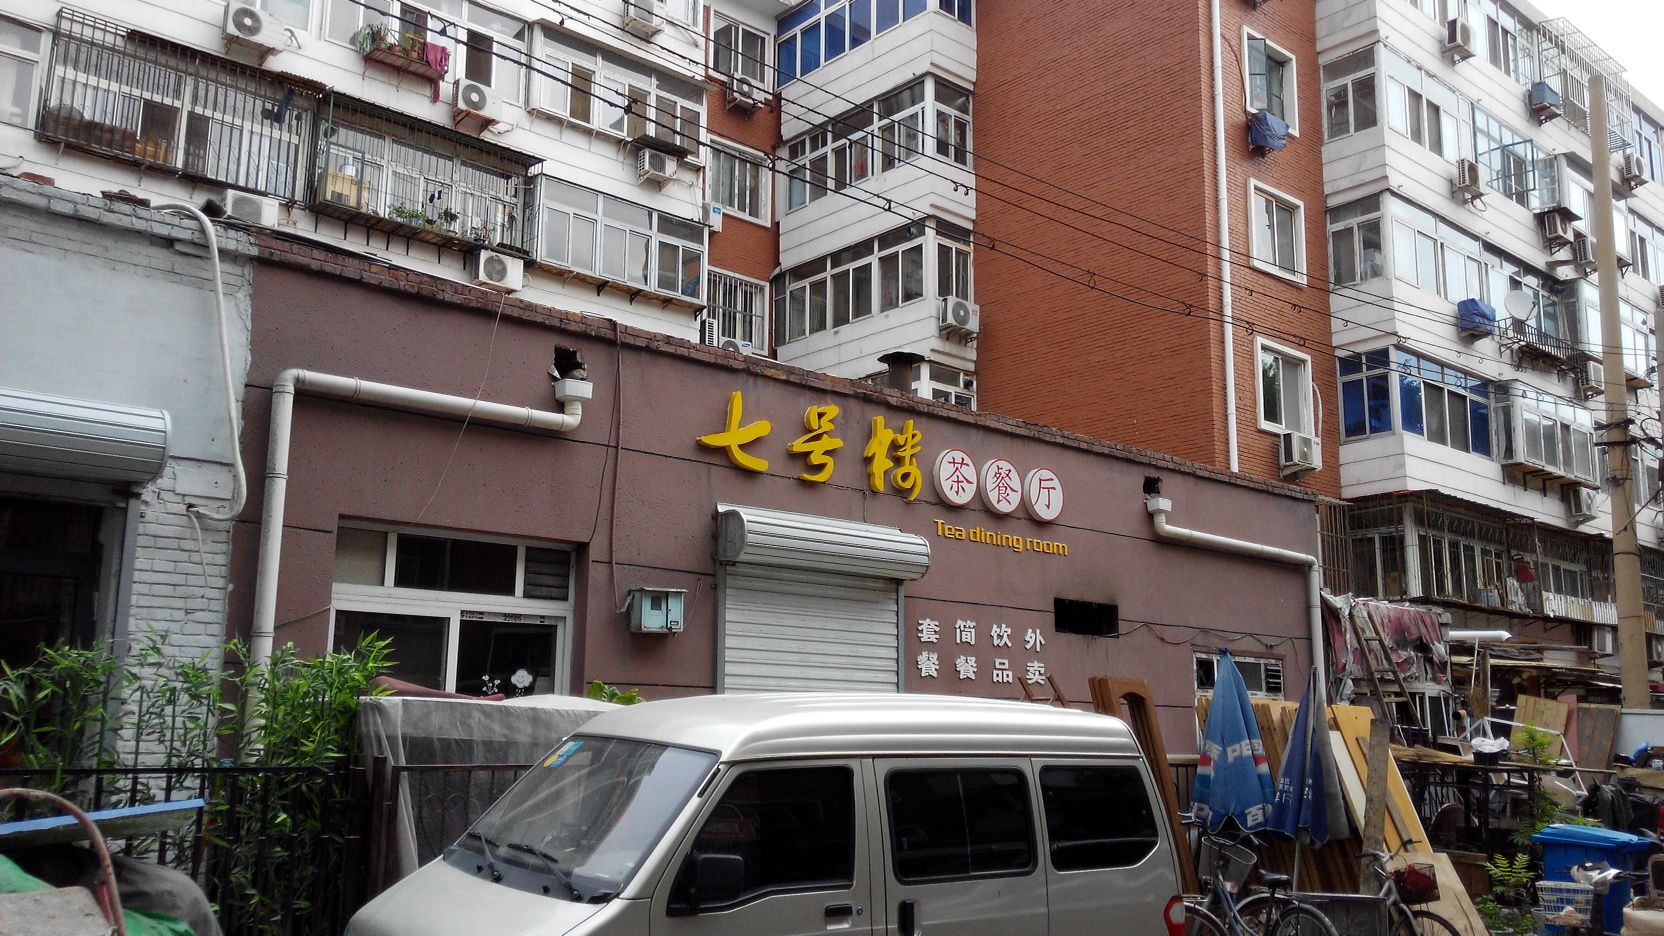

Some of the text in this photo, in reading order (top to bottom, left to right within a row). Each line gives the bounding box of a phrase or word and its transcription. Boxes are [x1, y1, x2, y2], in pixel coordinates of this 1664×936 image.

[696, 390, 1057, 510] 七号楼 茶餐厅
[934, 519, 1068, 555] Tea dining room
[917, 618, 941, 678] 套餐
[955, 619, 978, 680] 简餐
[991, 623, 1013, 683] 饮品
[1024, 628, 1046, 685] 外卖
